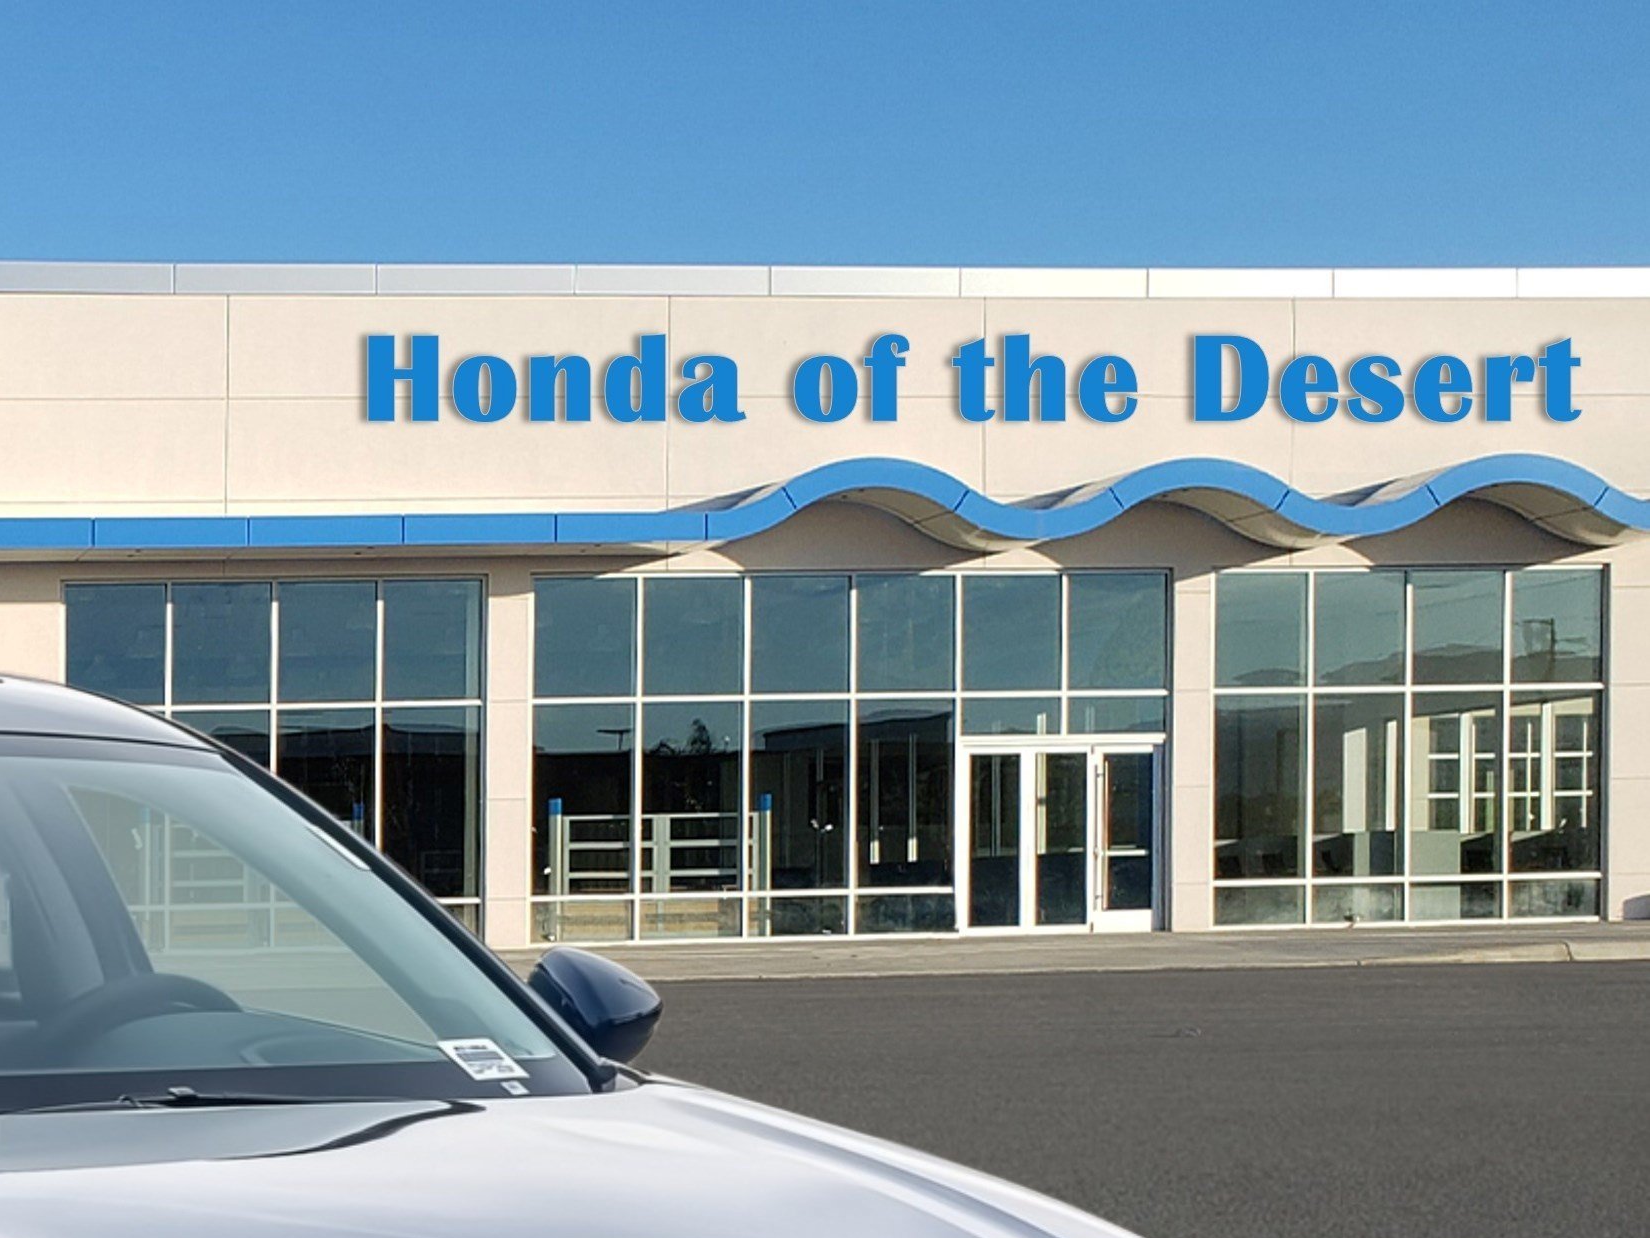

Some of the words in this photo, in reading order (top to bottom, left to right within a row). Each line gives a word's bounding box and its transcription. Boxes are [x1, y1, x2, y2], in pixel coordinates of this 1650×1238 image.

[363, 331, 746, 424] Honda
[792, 333, 910, 424] of
[951, 333, 1139, 423] the
[1191, 334, 1583, 424] Desert
